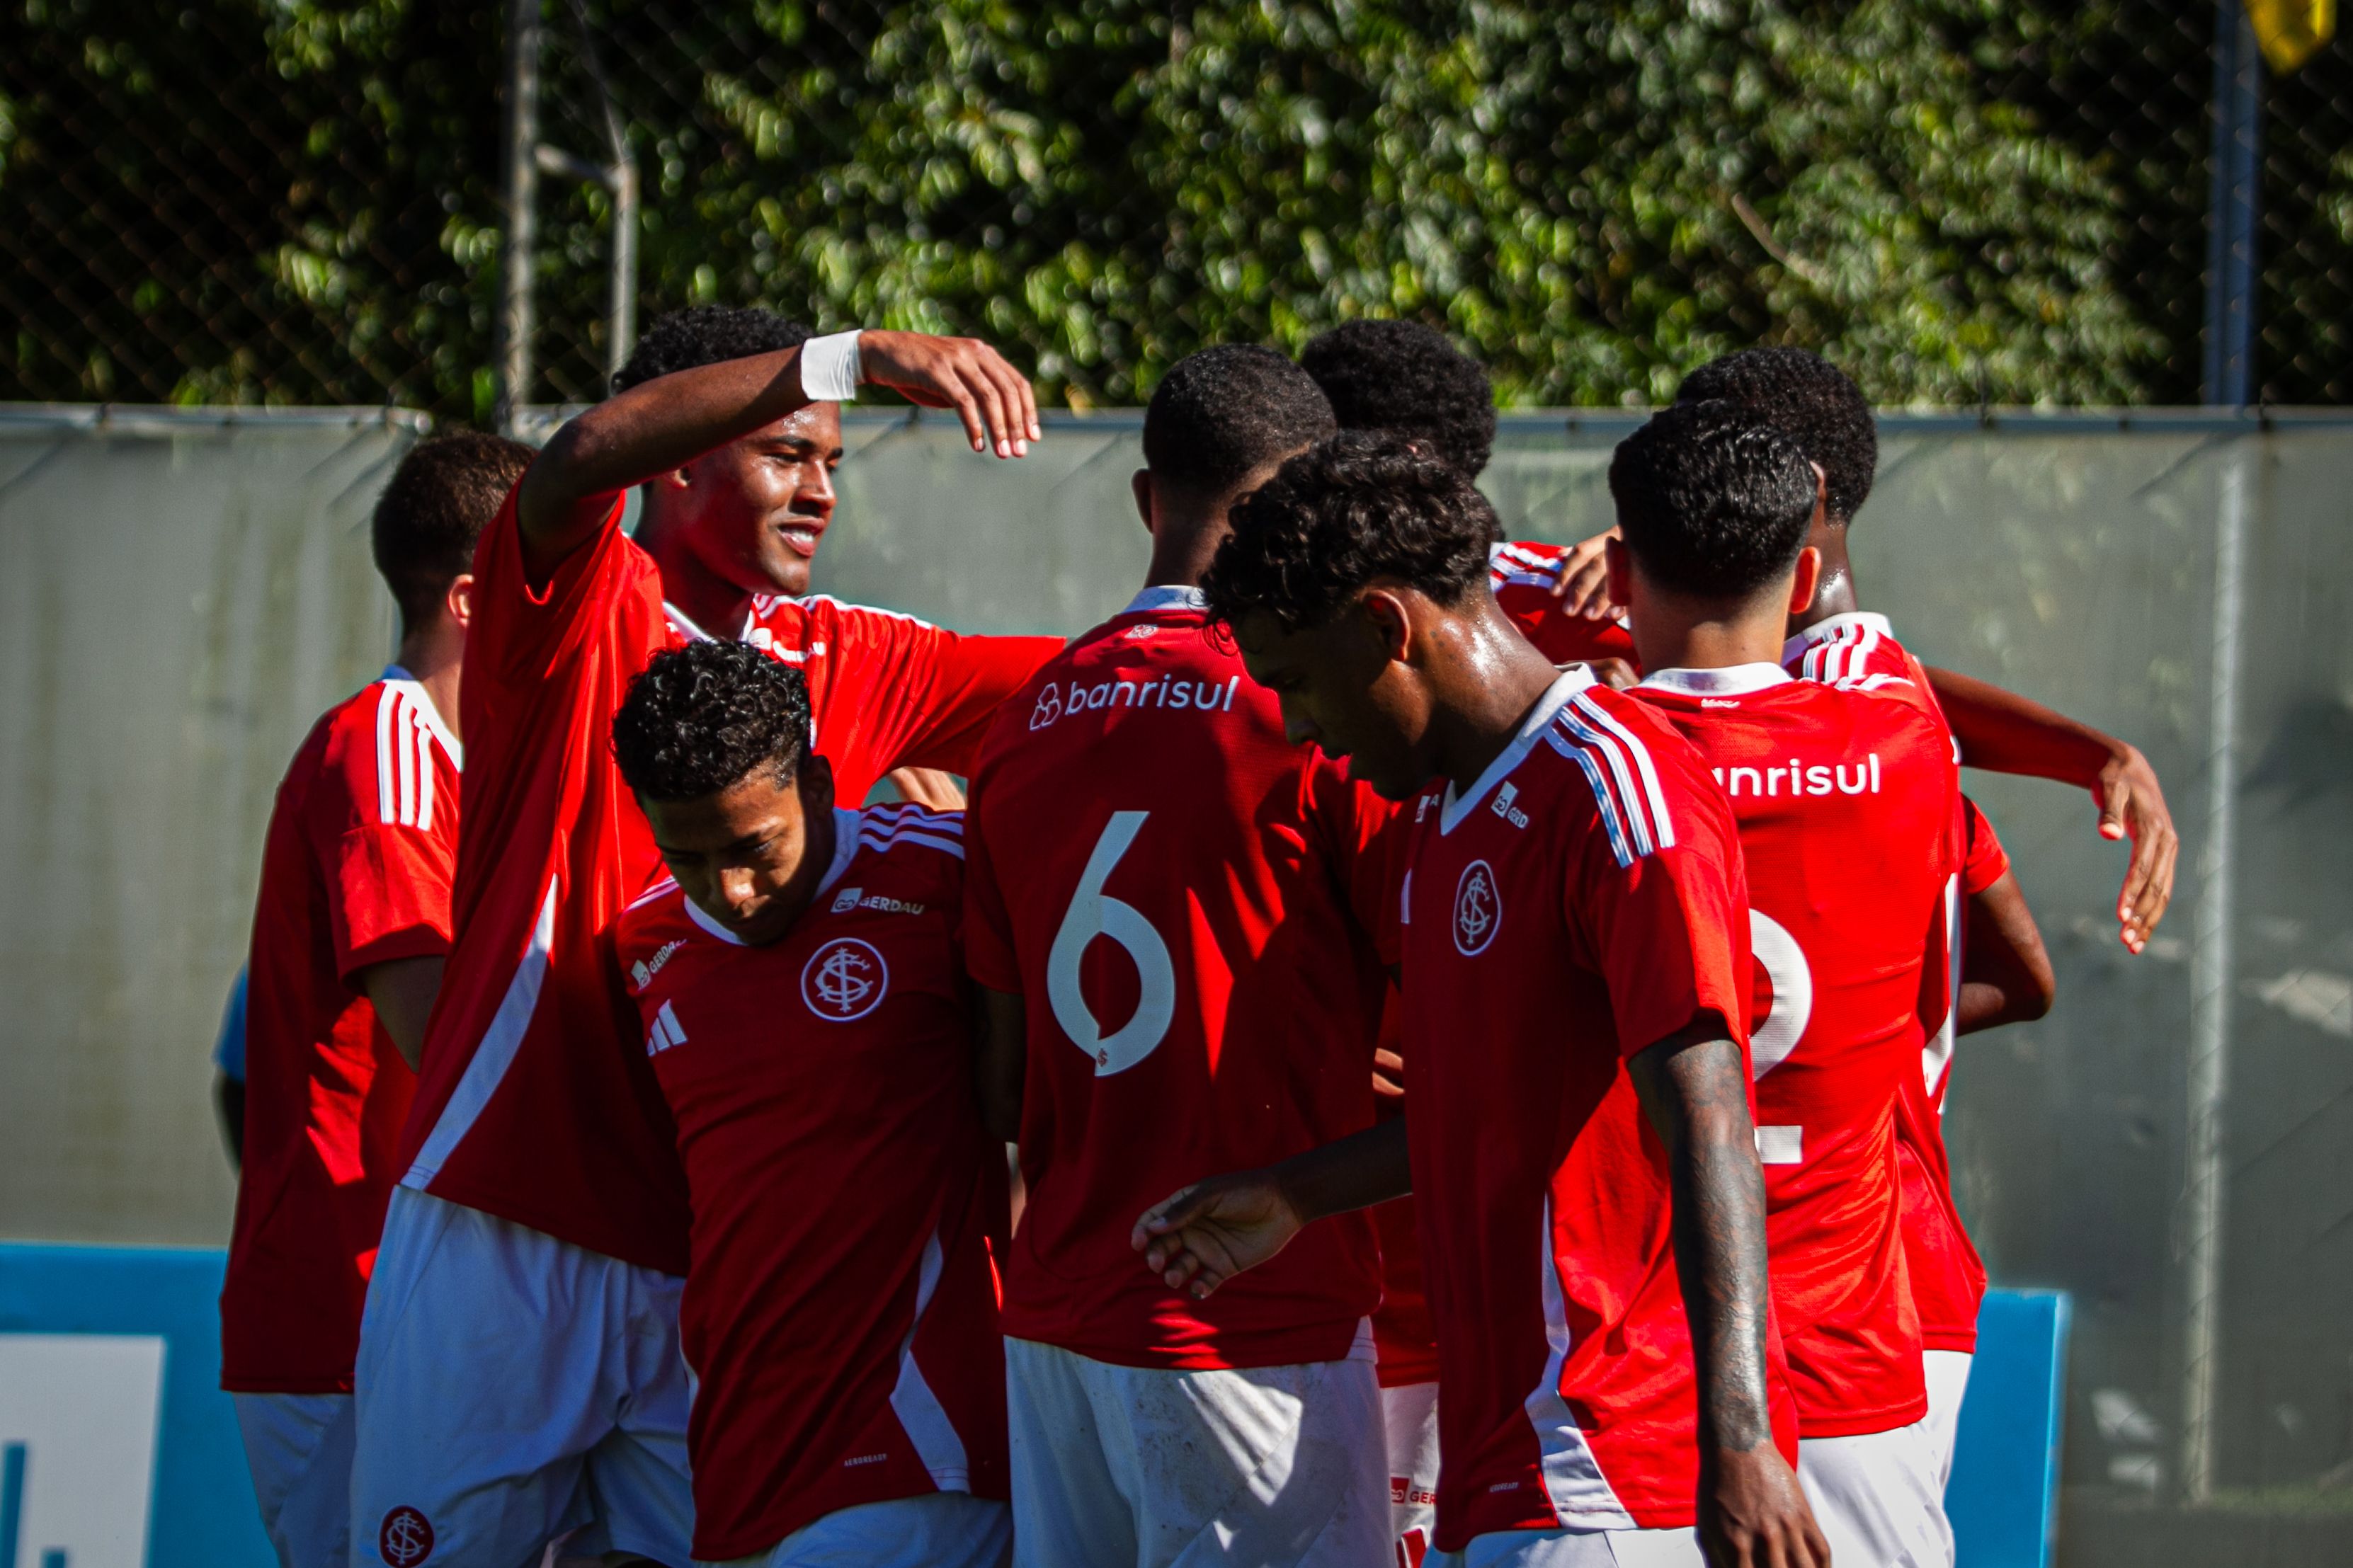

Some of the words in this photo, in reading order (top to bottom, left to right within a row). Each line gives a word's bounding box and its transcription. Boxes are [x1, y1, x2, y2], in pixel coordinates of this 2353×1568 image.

[1065, 674, 1239, 716] banrisul
[859, 895, 925, 915] GERDAU
[1047, 811, 1176, 1077] 6
